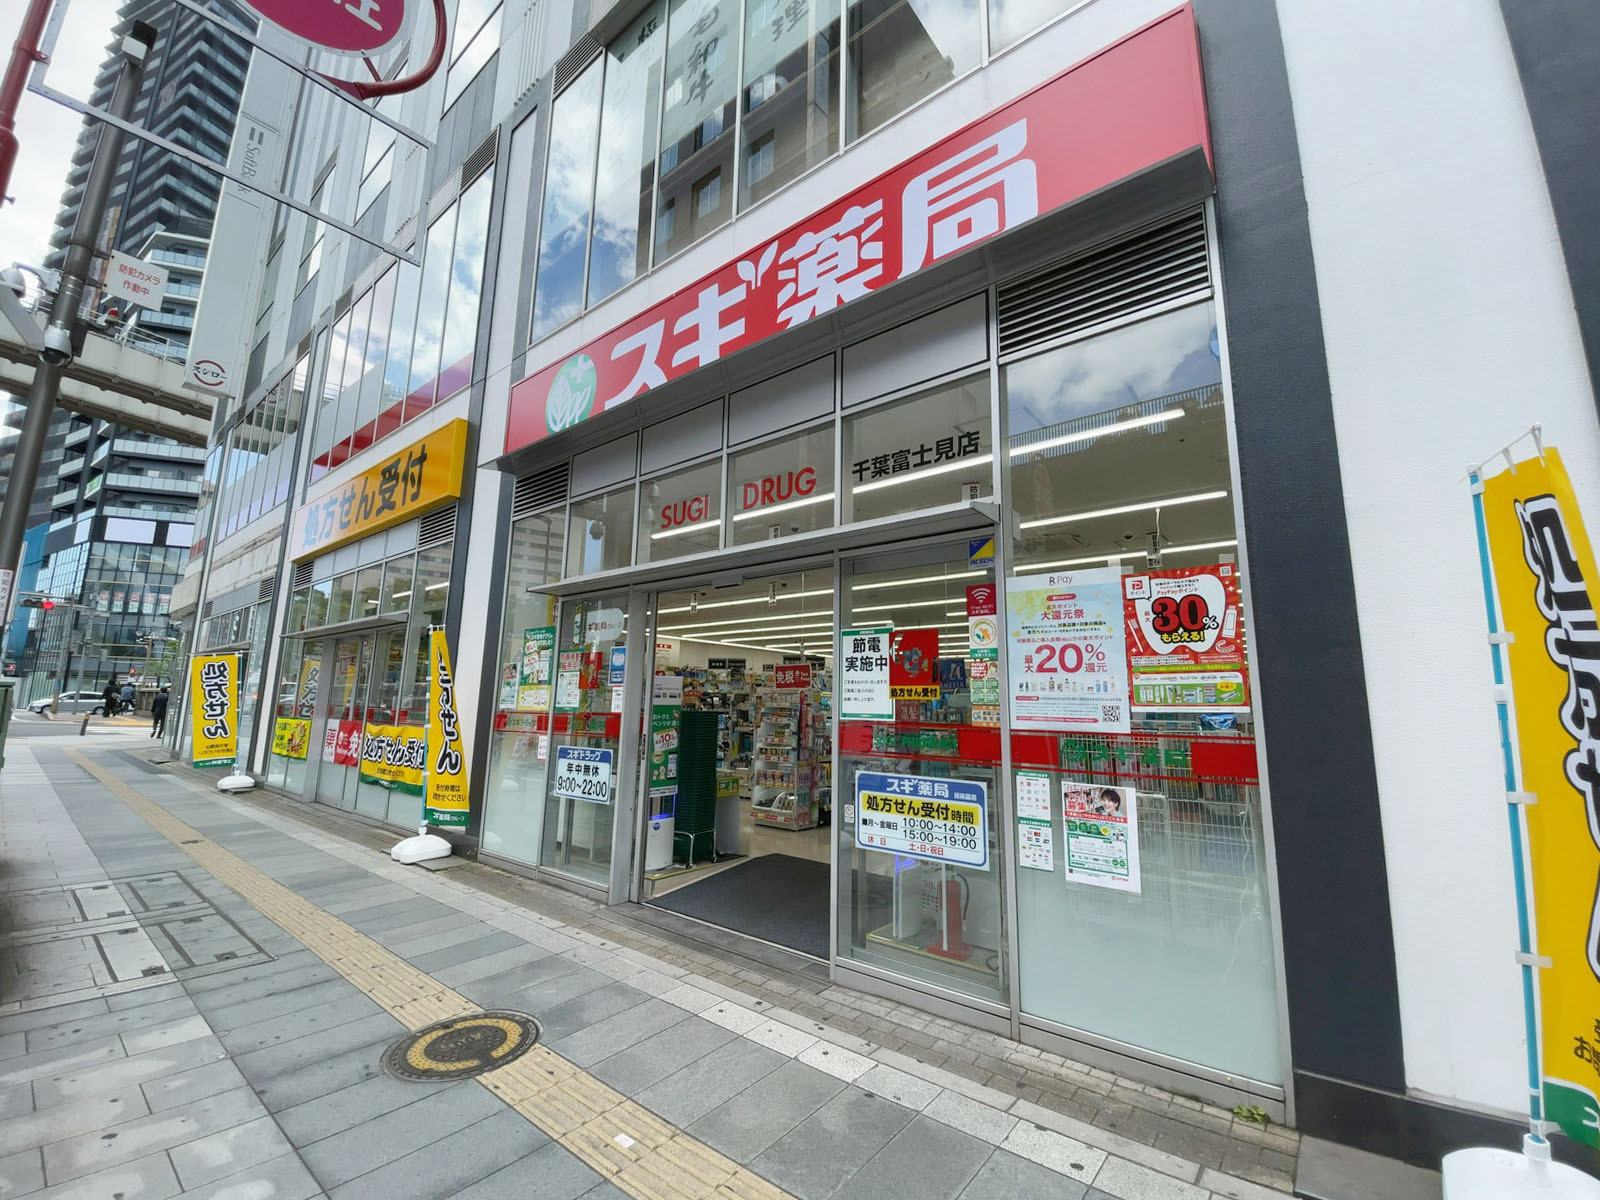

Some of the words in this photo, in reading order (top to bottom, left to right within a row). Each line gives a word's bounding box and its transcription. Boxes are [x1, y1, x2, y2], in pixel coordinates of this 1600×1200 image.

[236, 142, 261, 195] SoftBk
[118, 263, 161, 286] 防犯カメラ
[605, 117, 1039, 411] スギ薬局
[122, 281, 150, 297] 作動中
[192, 365, 229, 381] スシロー
[851, 430, 981, 483] 千葉富士見店
[303, 443, 428, 549] 処方せん受付
[742, 466, 817, 511] DRUG
[1041, 609, 1085, 621] 大還元祭
[1152, 594, 1219, 634] 30%
[852, 637, 881, 654] 節電
[845, 655, 888, 672] 実施中
[1034, 643, 1107, 674] 20%
[890, 687, 938, 698] 処方せん受付
[566, 749, 602, 761] スギドラッグ
[566, 762, 600, 778] 年中無休
[886, 777, 950, 798] スギ薬局
